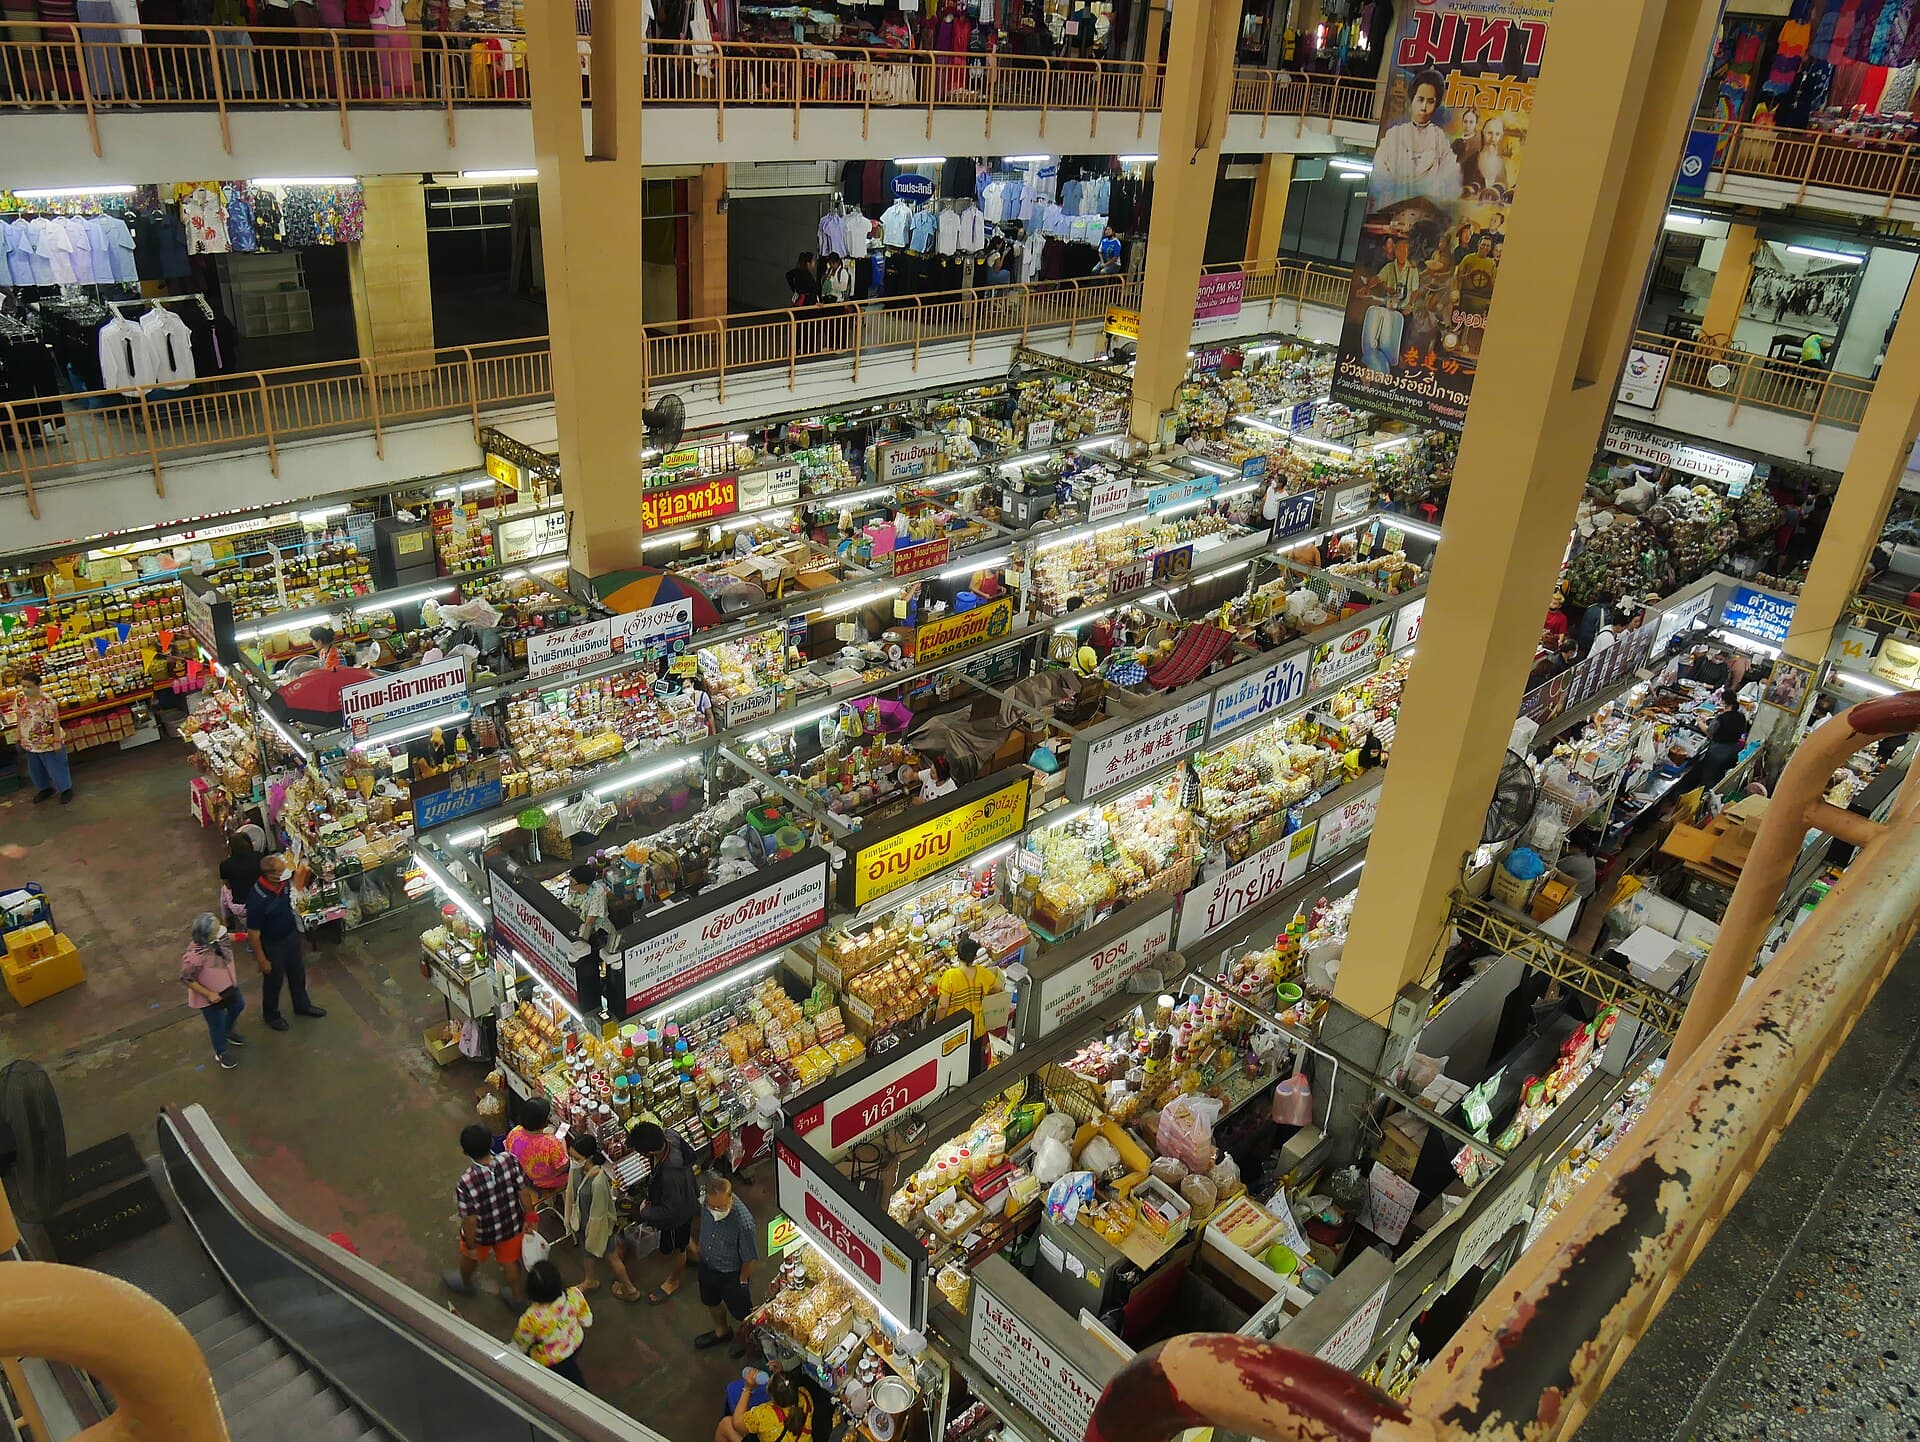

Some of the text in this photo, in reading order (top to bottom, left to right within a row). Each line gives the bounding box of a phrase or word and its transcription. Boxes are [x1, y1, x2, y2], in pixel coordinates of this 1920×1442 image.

[1216, 282, 1226, 293] FM
[1228, 279, 1242, 291] 99.5
[776, 469, 791, 482] นุช
[642, 481, 734, 529] มูยอหนัง
[1112, 566, 1144, 593] ป้าย่น
[546, 634, 566, 647] ร้าน
[1216, 680, 1261, 717] กุนเชียง
[1258, 660, 1304, 713] มีฟ้า
[868, 831, 952, 880] อัญชัญ
[1204, 862, 1286, 934] ป้าย่น
[797, 1113, 818, 1130] ร้าน
[862, 1085, 909, 1126] หล้า
[816, 1211, 865, 1269] หล้า
